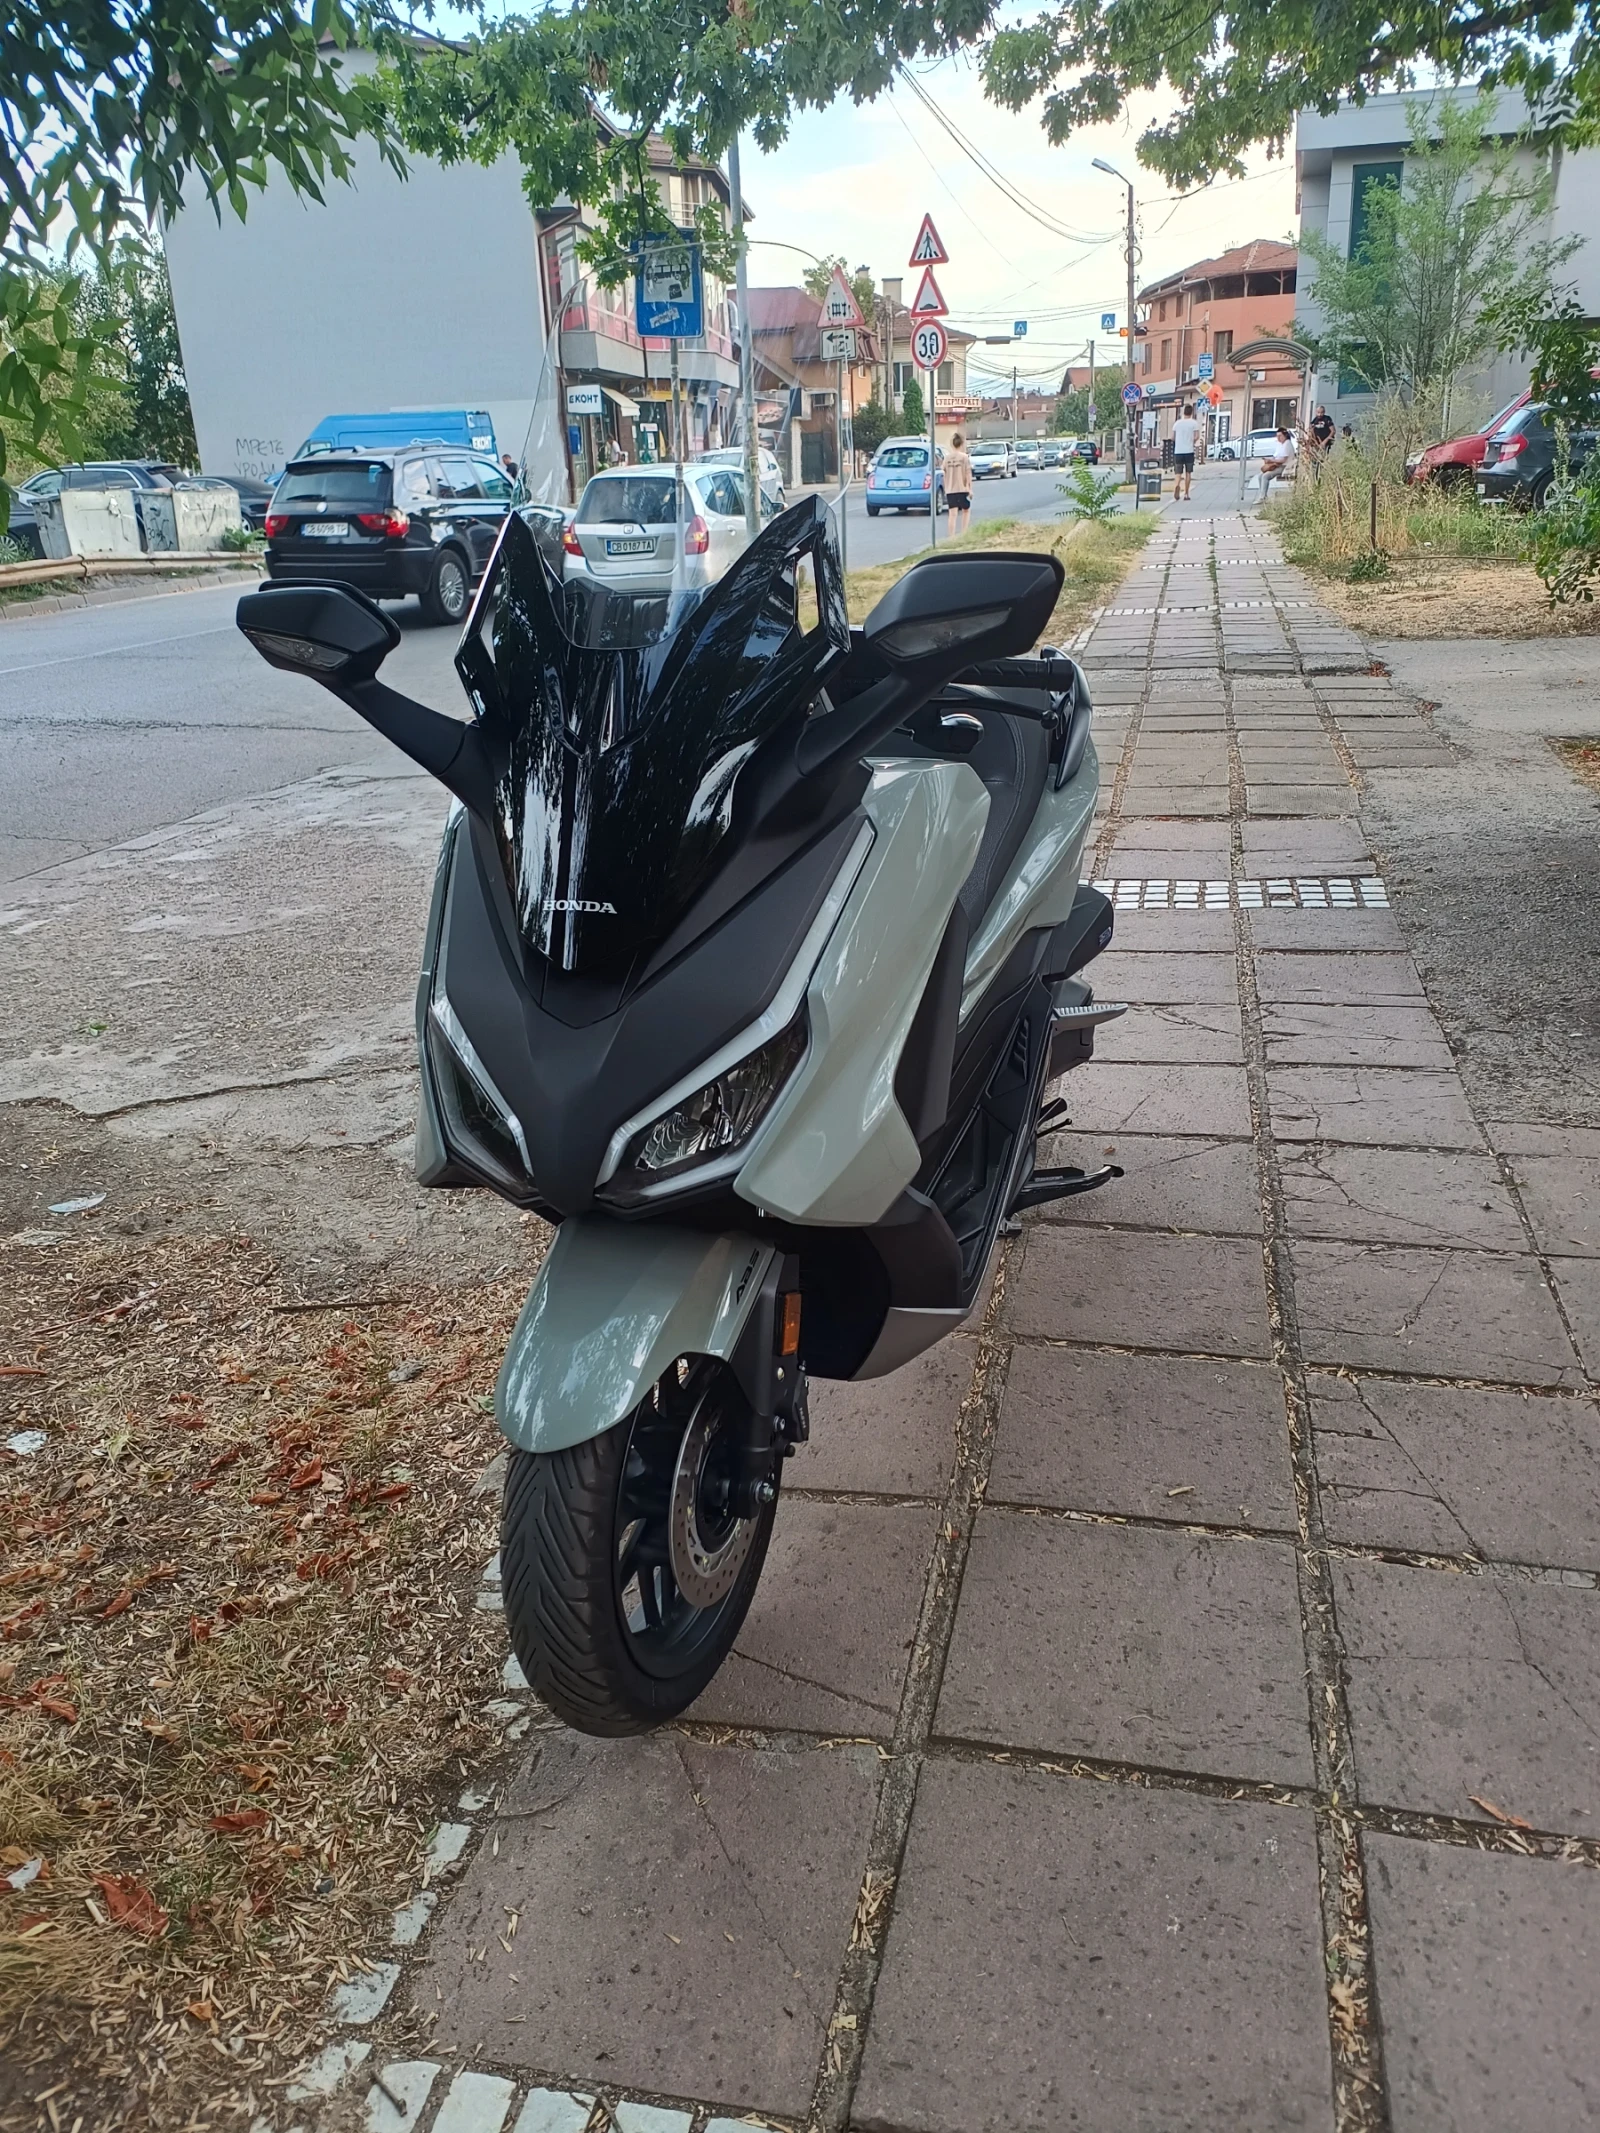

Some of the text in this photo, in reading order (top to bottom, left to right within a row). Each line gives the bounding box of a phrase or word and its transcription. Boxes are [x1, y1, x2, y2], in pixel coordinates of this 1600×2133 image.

[918, 332, 939, 358] 30
[569, 394, 599, 404] ЕКОНТ
[935, 398, 979, 406] СУПЕРМАРКЕТ
[236, 438, 284, 457] МРЕТЕ
[612, 540, 652, 552] CB 0187 TA
[542, 900, 617, 914] HONDA
[736, 1247, 759, 1306] ABS
